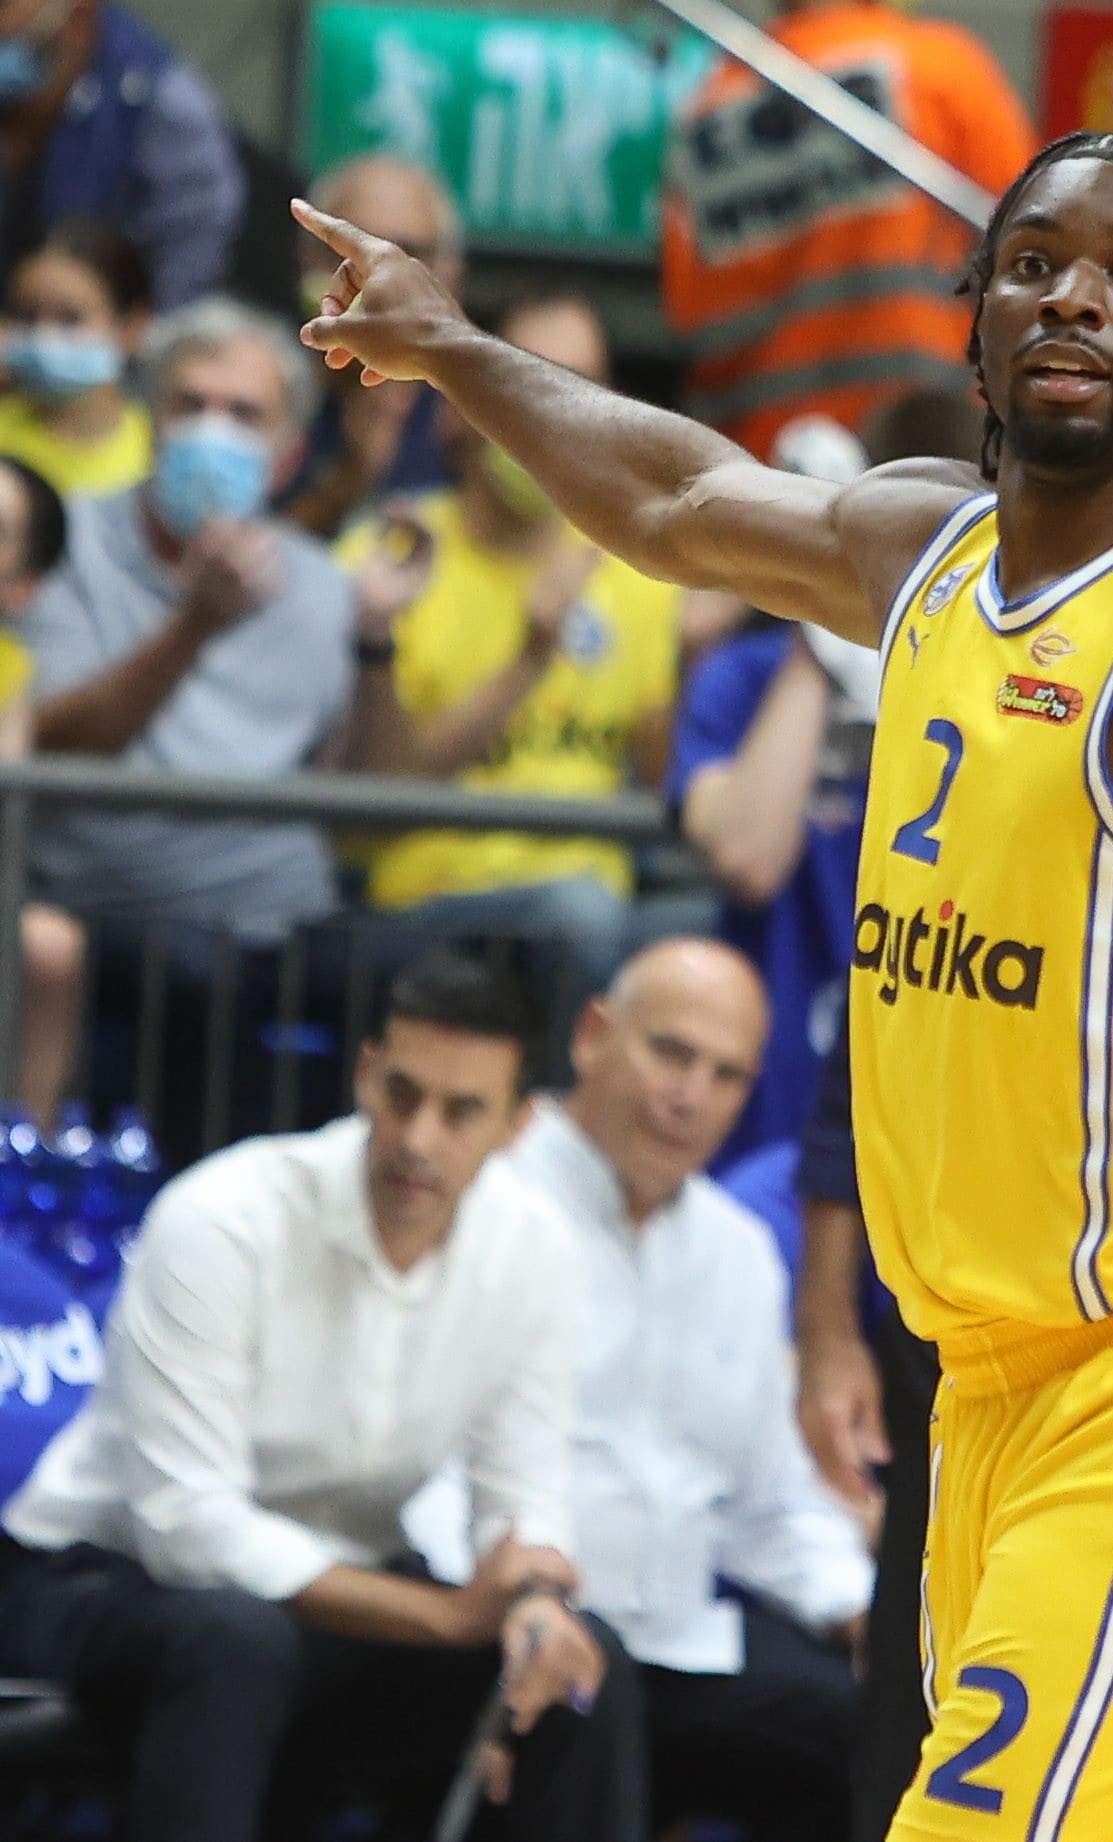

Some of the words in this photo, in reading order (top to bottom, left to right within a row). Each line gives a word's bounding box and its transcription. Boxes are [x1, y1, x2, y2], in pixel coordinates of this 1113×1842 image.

[891, 718, 964, 866] 2
[851, 898, 1045, 1011] aytika
[925, 1666, 1029, 1814] 2
